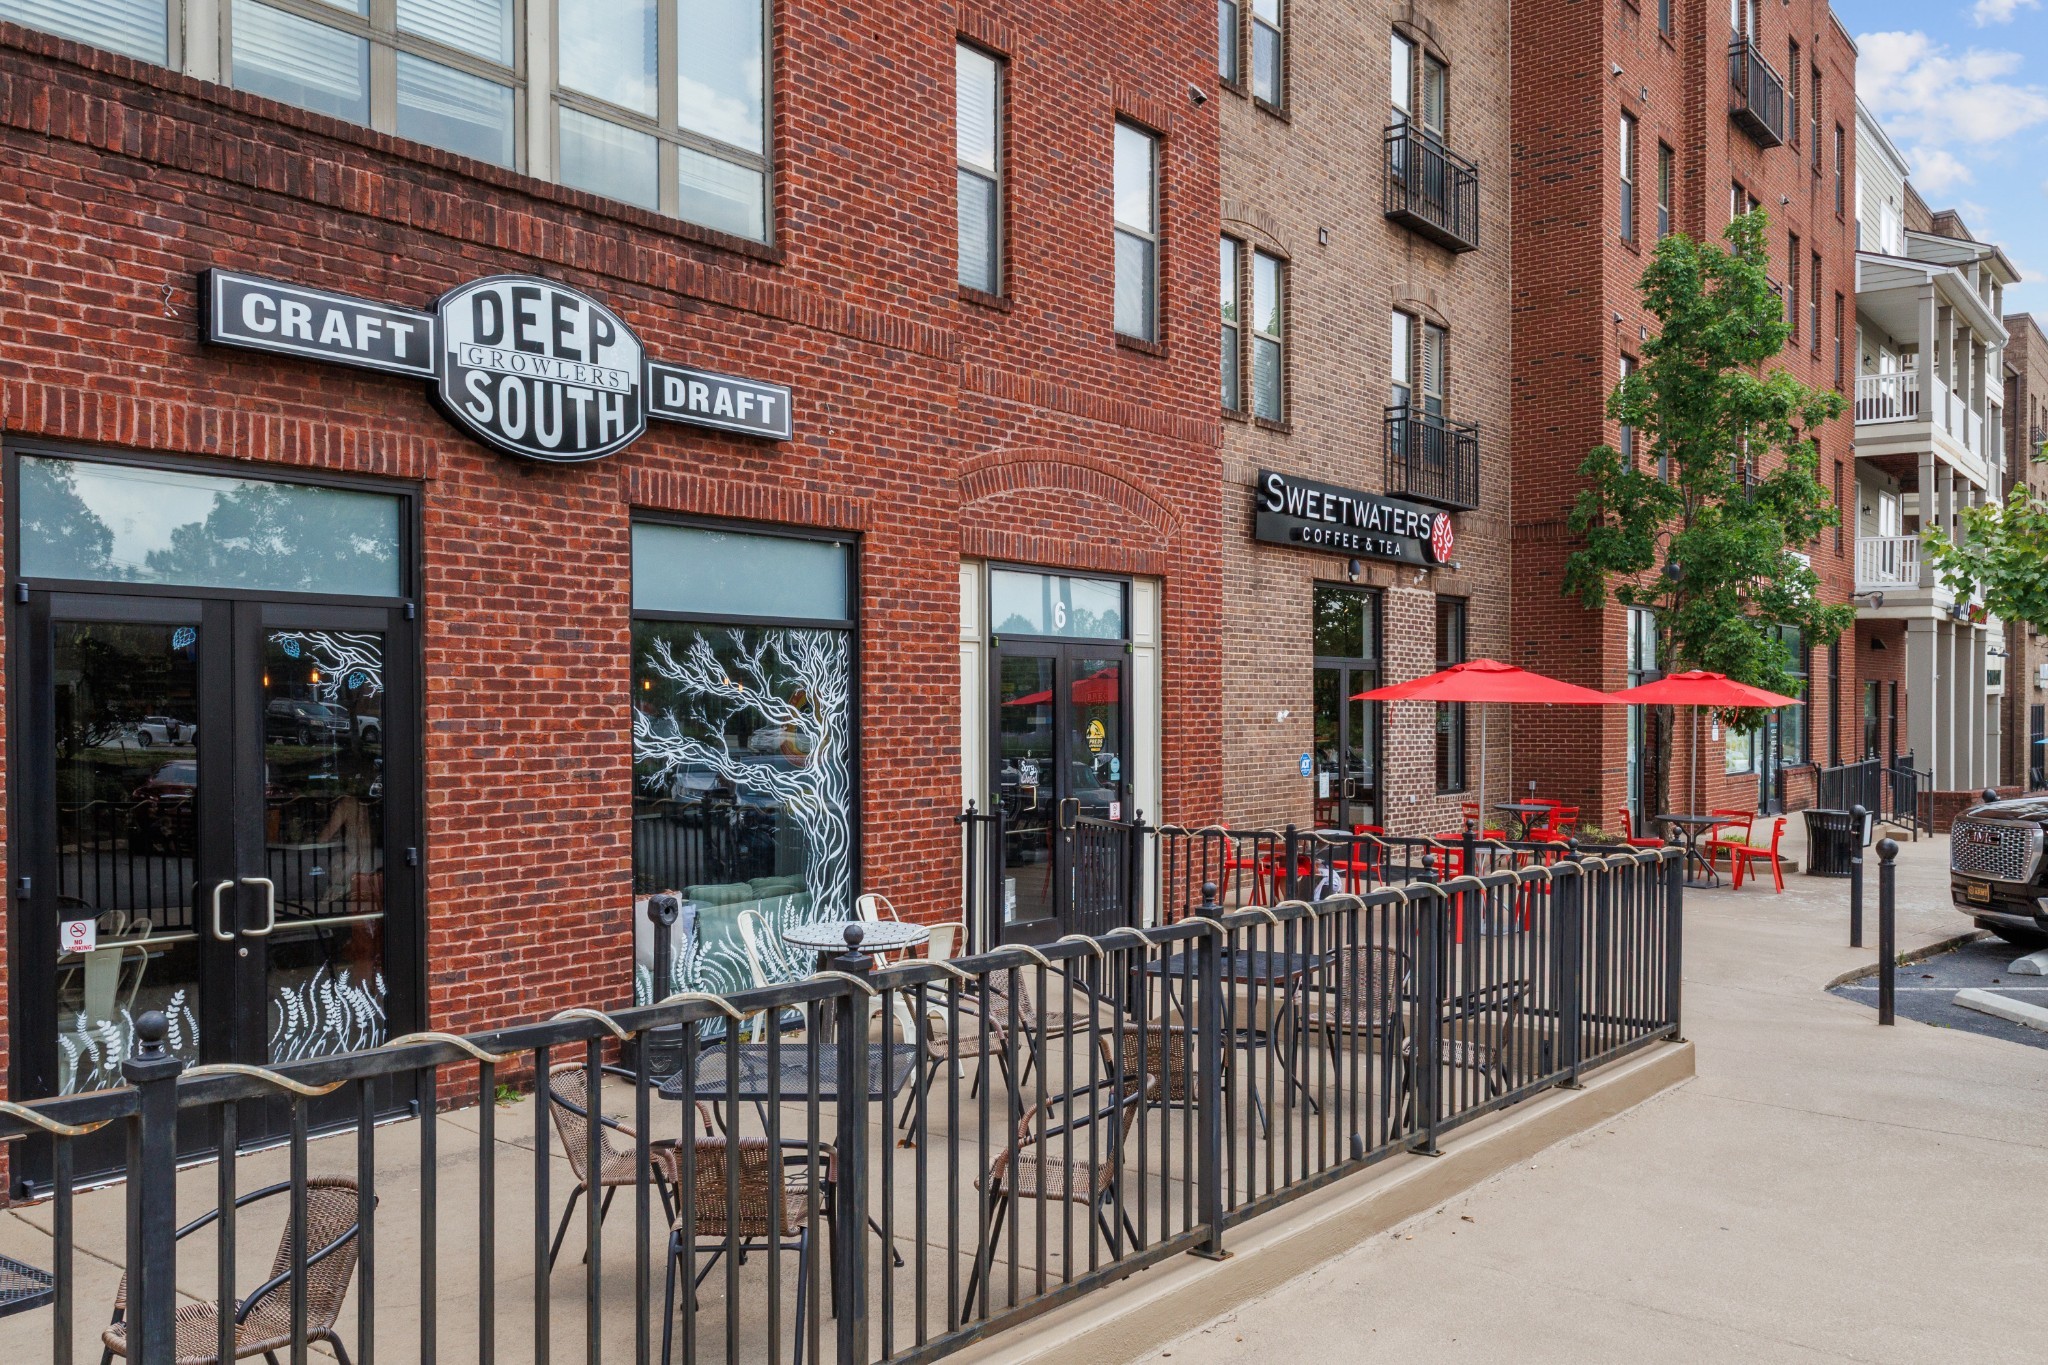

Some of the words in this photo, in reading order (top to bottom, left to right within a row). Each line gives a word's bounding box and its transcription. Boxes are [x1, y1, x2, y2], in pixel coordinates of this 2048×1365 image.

[242, 292, 414, 360] CRAFT
[472, 286, 616, 359] DEEP
[468, 347, 620, 388] GROWLERS
[465, 371, 624, 449] SOUTH
[664, 376, 775, 425] DRAFT
[1267, 473, 1430, 539] SWEETWATERS
[1303, 527, 1359, 549] COFFEE
[1365, 538, 1373, 551] &
[1379, 540, 1401, 556] TEA
[1054, 602, 1066, 629] 6
[1967, 831, 2001, 845] GMC
